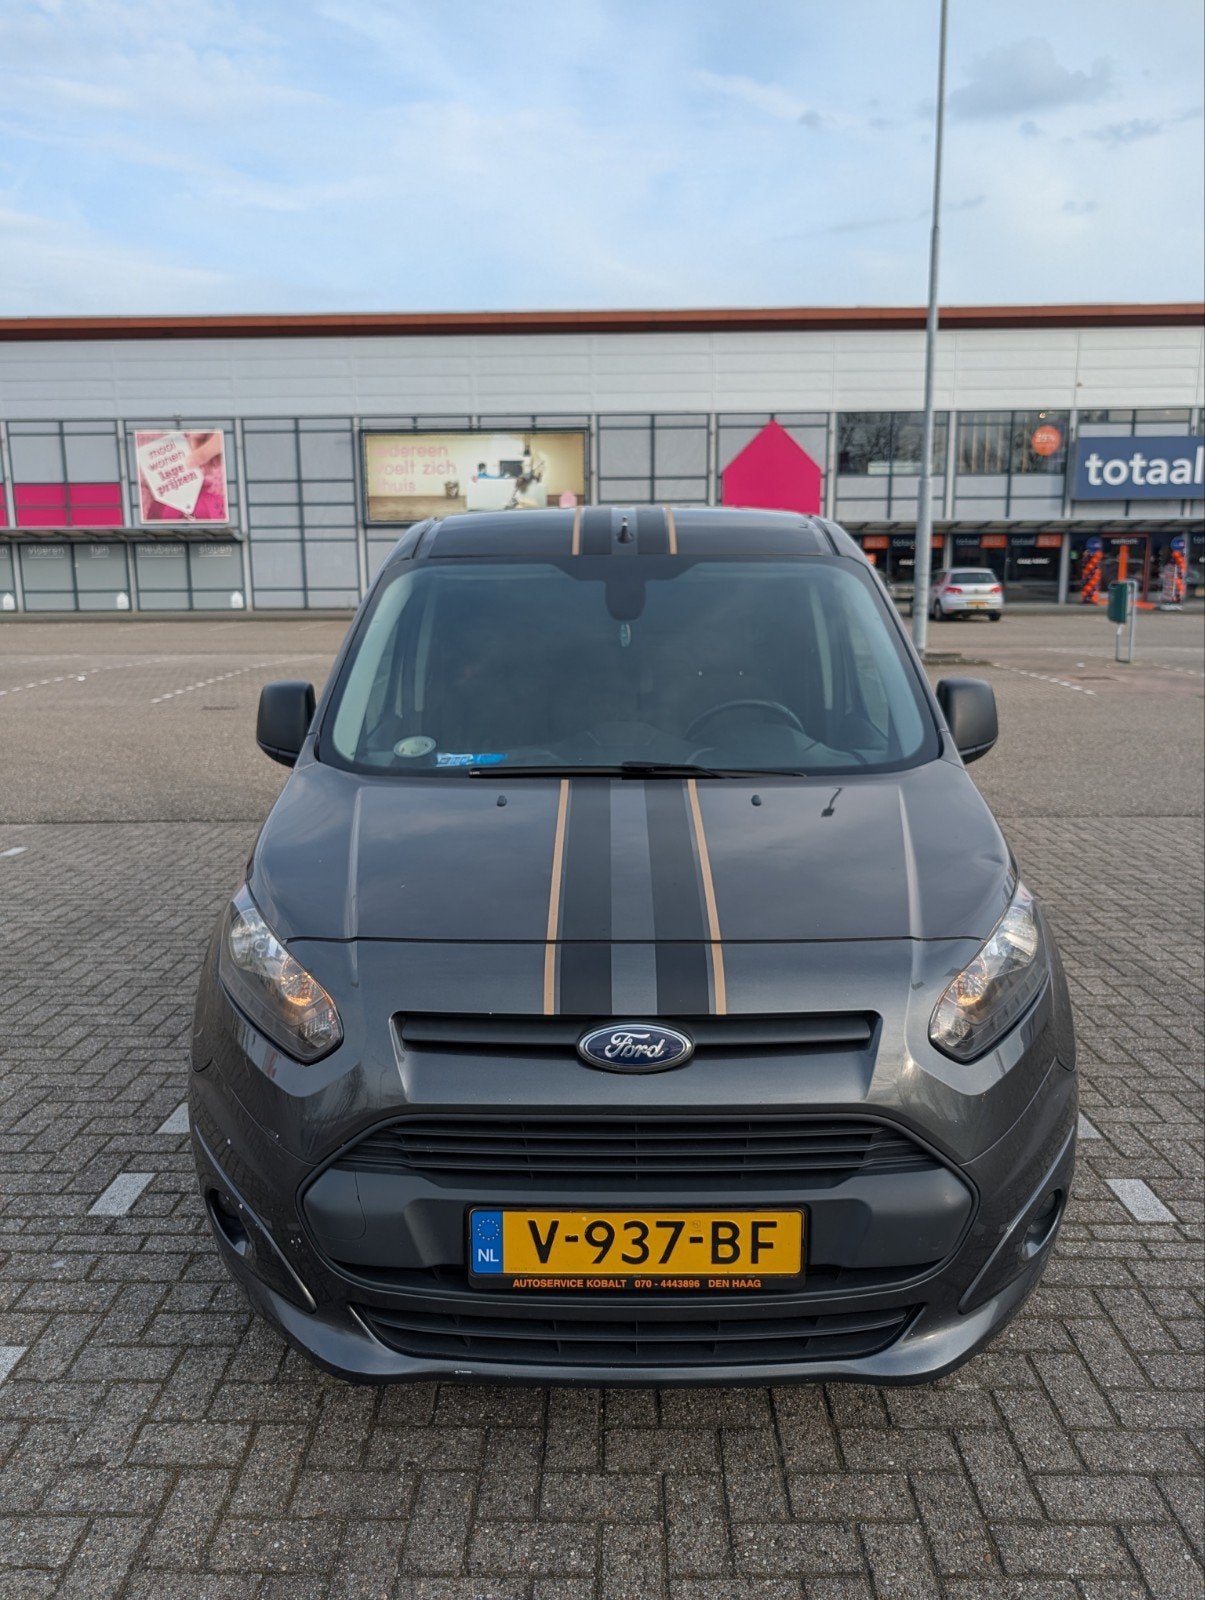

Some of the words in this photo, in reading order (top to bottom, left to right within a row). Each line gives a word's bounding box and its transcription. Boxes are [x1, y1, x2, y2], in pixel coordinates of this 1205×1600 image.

[422, 458, 457, 475] zich
[1084, 446, 1204, 486] totaal
[604, 1032, 666, 1058] Ford
[527, 1220, 778, 1265] V-937-BF
[477, 1248, 499, 1263] NL
[512, 1278, 584, 1289] AUTOSERVICE
[586, 1278, 627, 1289] KOBALT
[634, 1278, 652, 1289] 070
[660, 1278, 701, 1289] 4443896
[708, 1278, 730, 1289] DEN
[732, 1278, 762, 1289] HAAG
